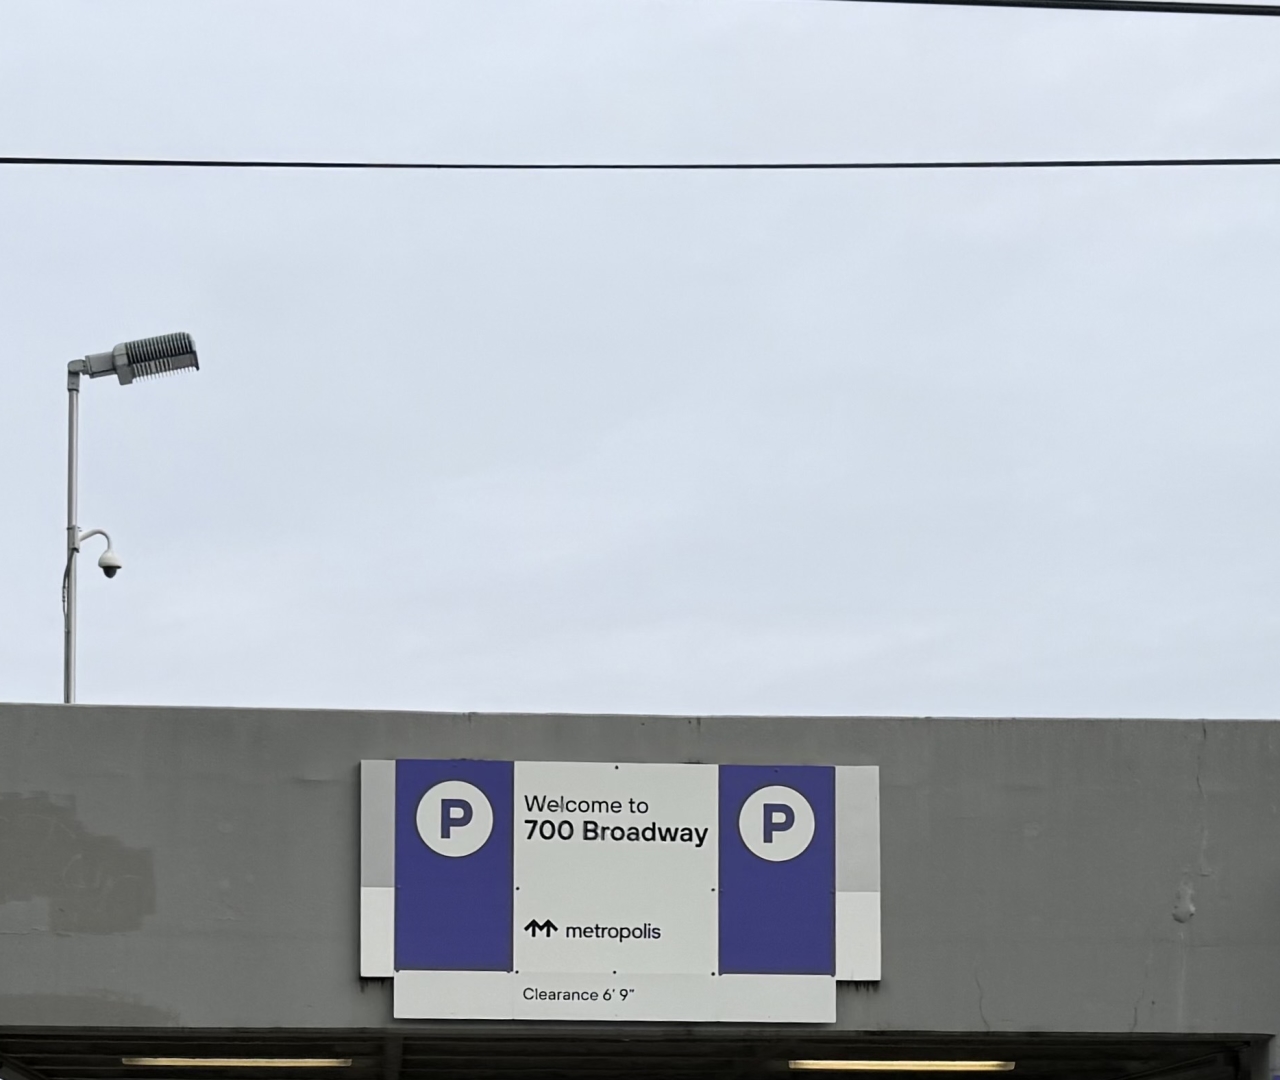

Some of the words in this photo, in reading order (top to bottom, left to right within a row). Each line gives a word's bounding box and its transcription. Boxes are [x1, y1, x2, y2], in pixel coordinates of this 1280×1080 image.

[524, 795, 622, 813] Welcome
[628, 798, 649, 814] to
[441, 798, 473, 839] P
[763, 803, 795, 843] P
[524, 819, 574, 840] 700
[583, 820, 709, 848] Broadway
[566, 923, 661, 942] metropolis
[523, 987, 599, 1001] Clearance
